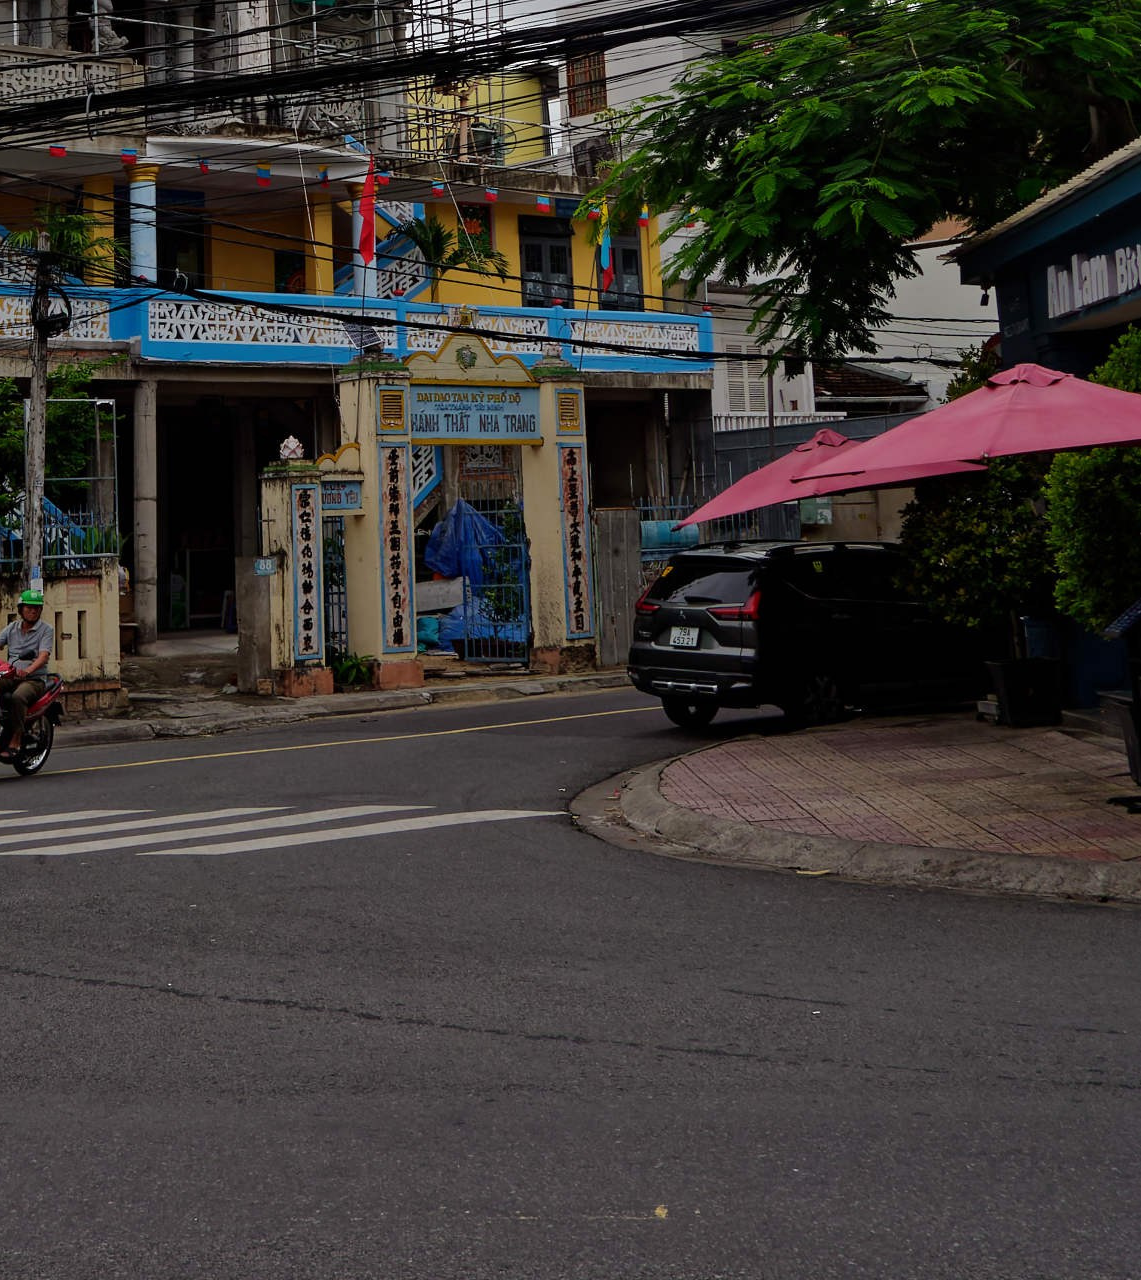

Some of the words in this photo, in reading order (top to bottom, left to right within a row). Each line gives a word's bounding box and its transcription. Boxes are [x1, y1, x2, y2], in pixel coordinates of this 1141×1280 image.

[1047, 265, 1071, 320] An
[1071, 253, 1110, 309] Lam
[479, 414, 500, 433] NHA
[503, 414, 536, 433] TRANG
